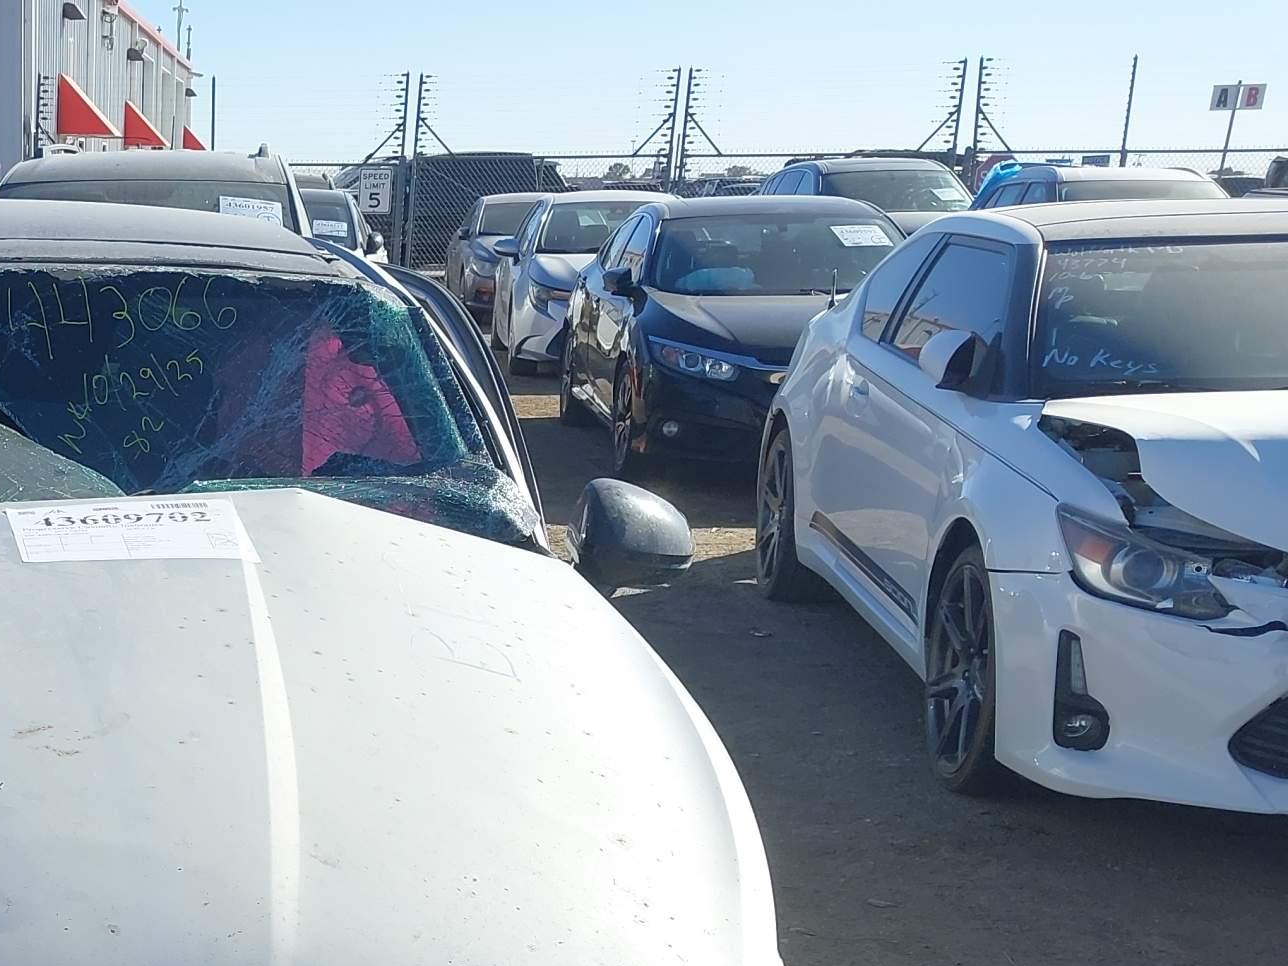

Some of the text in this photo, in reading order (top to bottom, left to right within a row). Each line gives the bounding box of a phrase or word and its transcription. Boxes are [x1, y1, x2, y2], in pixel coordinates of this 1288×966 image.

[1216, 86, 1259, 108] A B
[368, 192, 381, 209] 5
[1042, 348, 1161, 376] No Keys
[33, 511, 212, 528] 43609702
